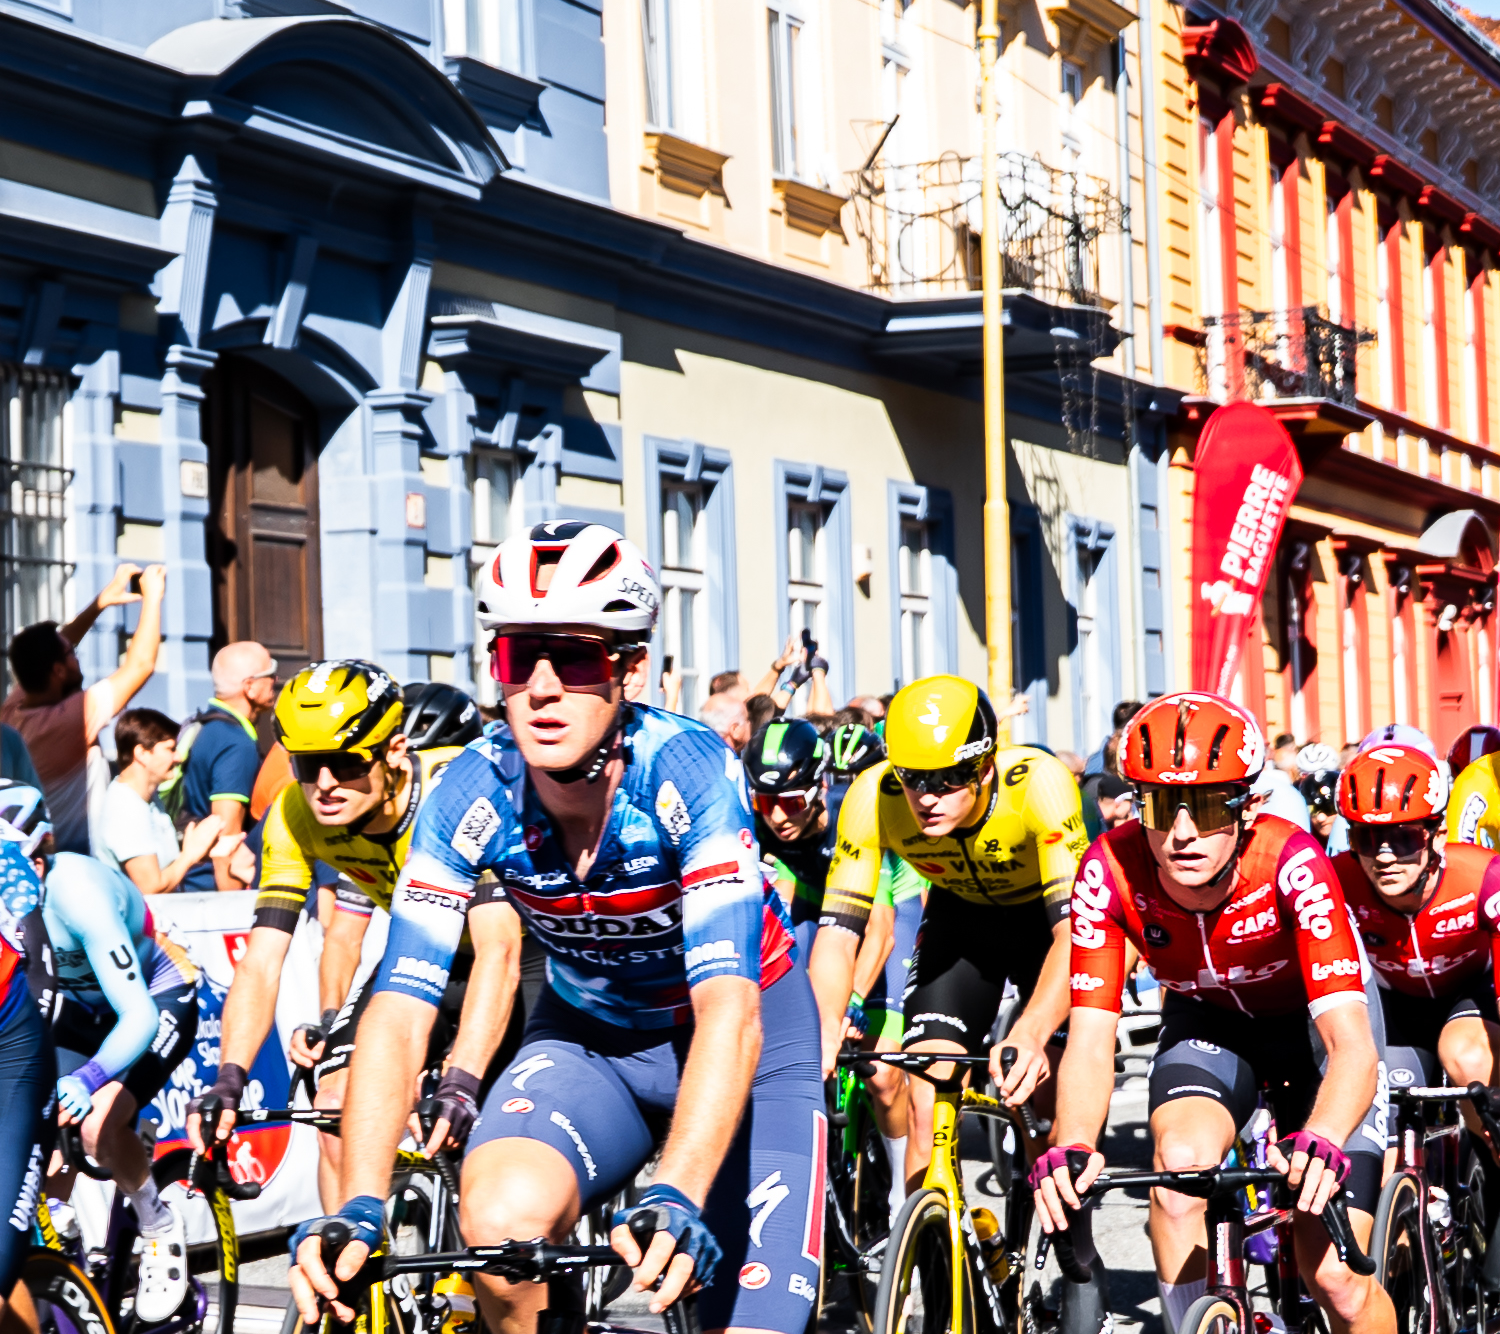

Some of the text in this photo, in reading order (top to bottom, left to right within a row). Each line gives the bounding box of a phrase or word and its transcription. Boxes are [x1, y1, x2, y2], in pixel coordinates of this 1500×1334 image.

[1220, 463, 1277, 580] PIERRE
[1242, 473, 1290, 587] BAGUETTE
[1231, 906, 1278, 938] CAPS
[1435, 910, 1476, 934] CAPS
